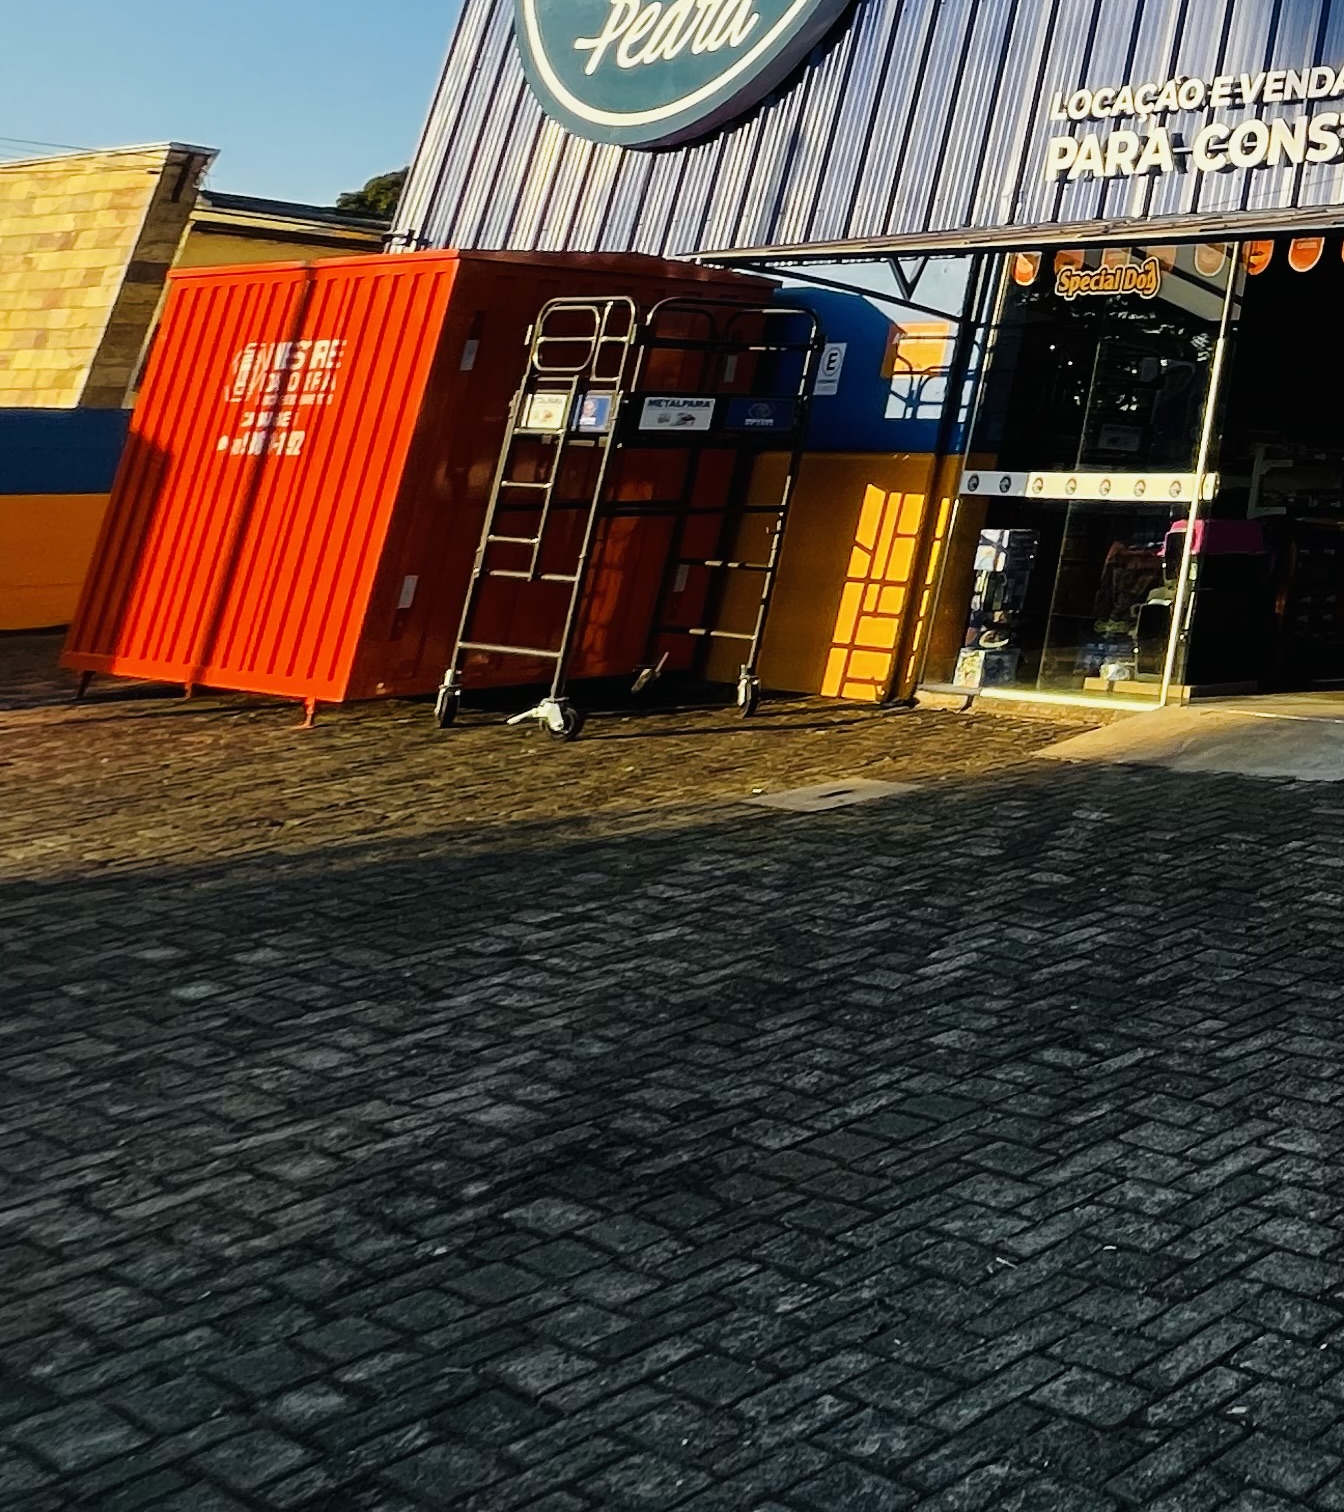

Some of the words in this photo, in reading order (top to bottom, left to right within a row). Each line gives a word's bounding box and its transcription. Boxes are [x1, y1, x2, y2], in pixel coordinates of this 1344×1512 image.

[1050, 76, 1206, 123] LOCAÇÃO
[1209, 74, 1236, 108] E
[1045, 127, 1174, 181] PARA
[1058, 266, 1120, 298] Special
[1123, 258, 1159, 298] Dog
[826, 352, 838, 371] E
